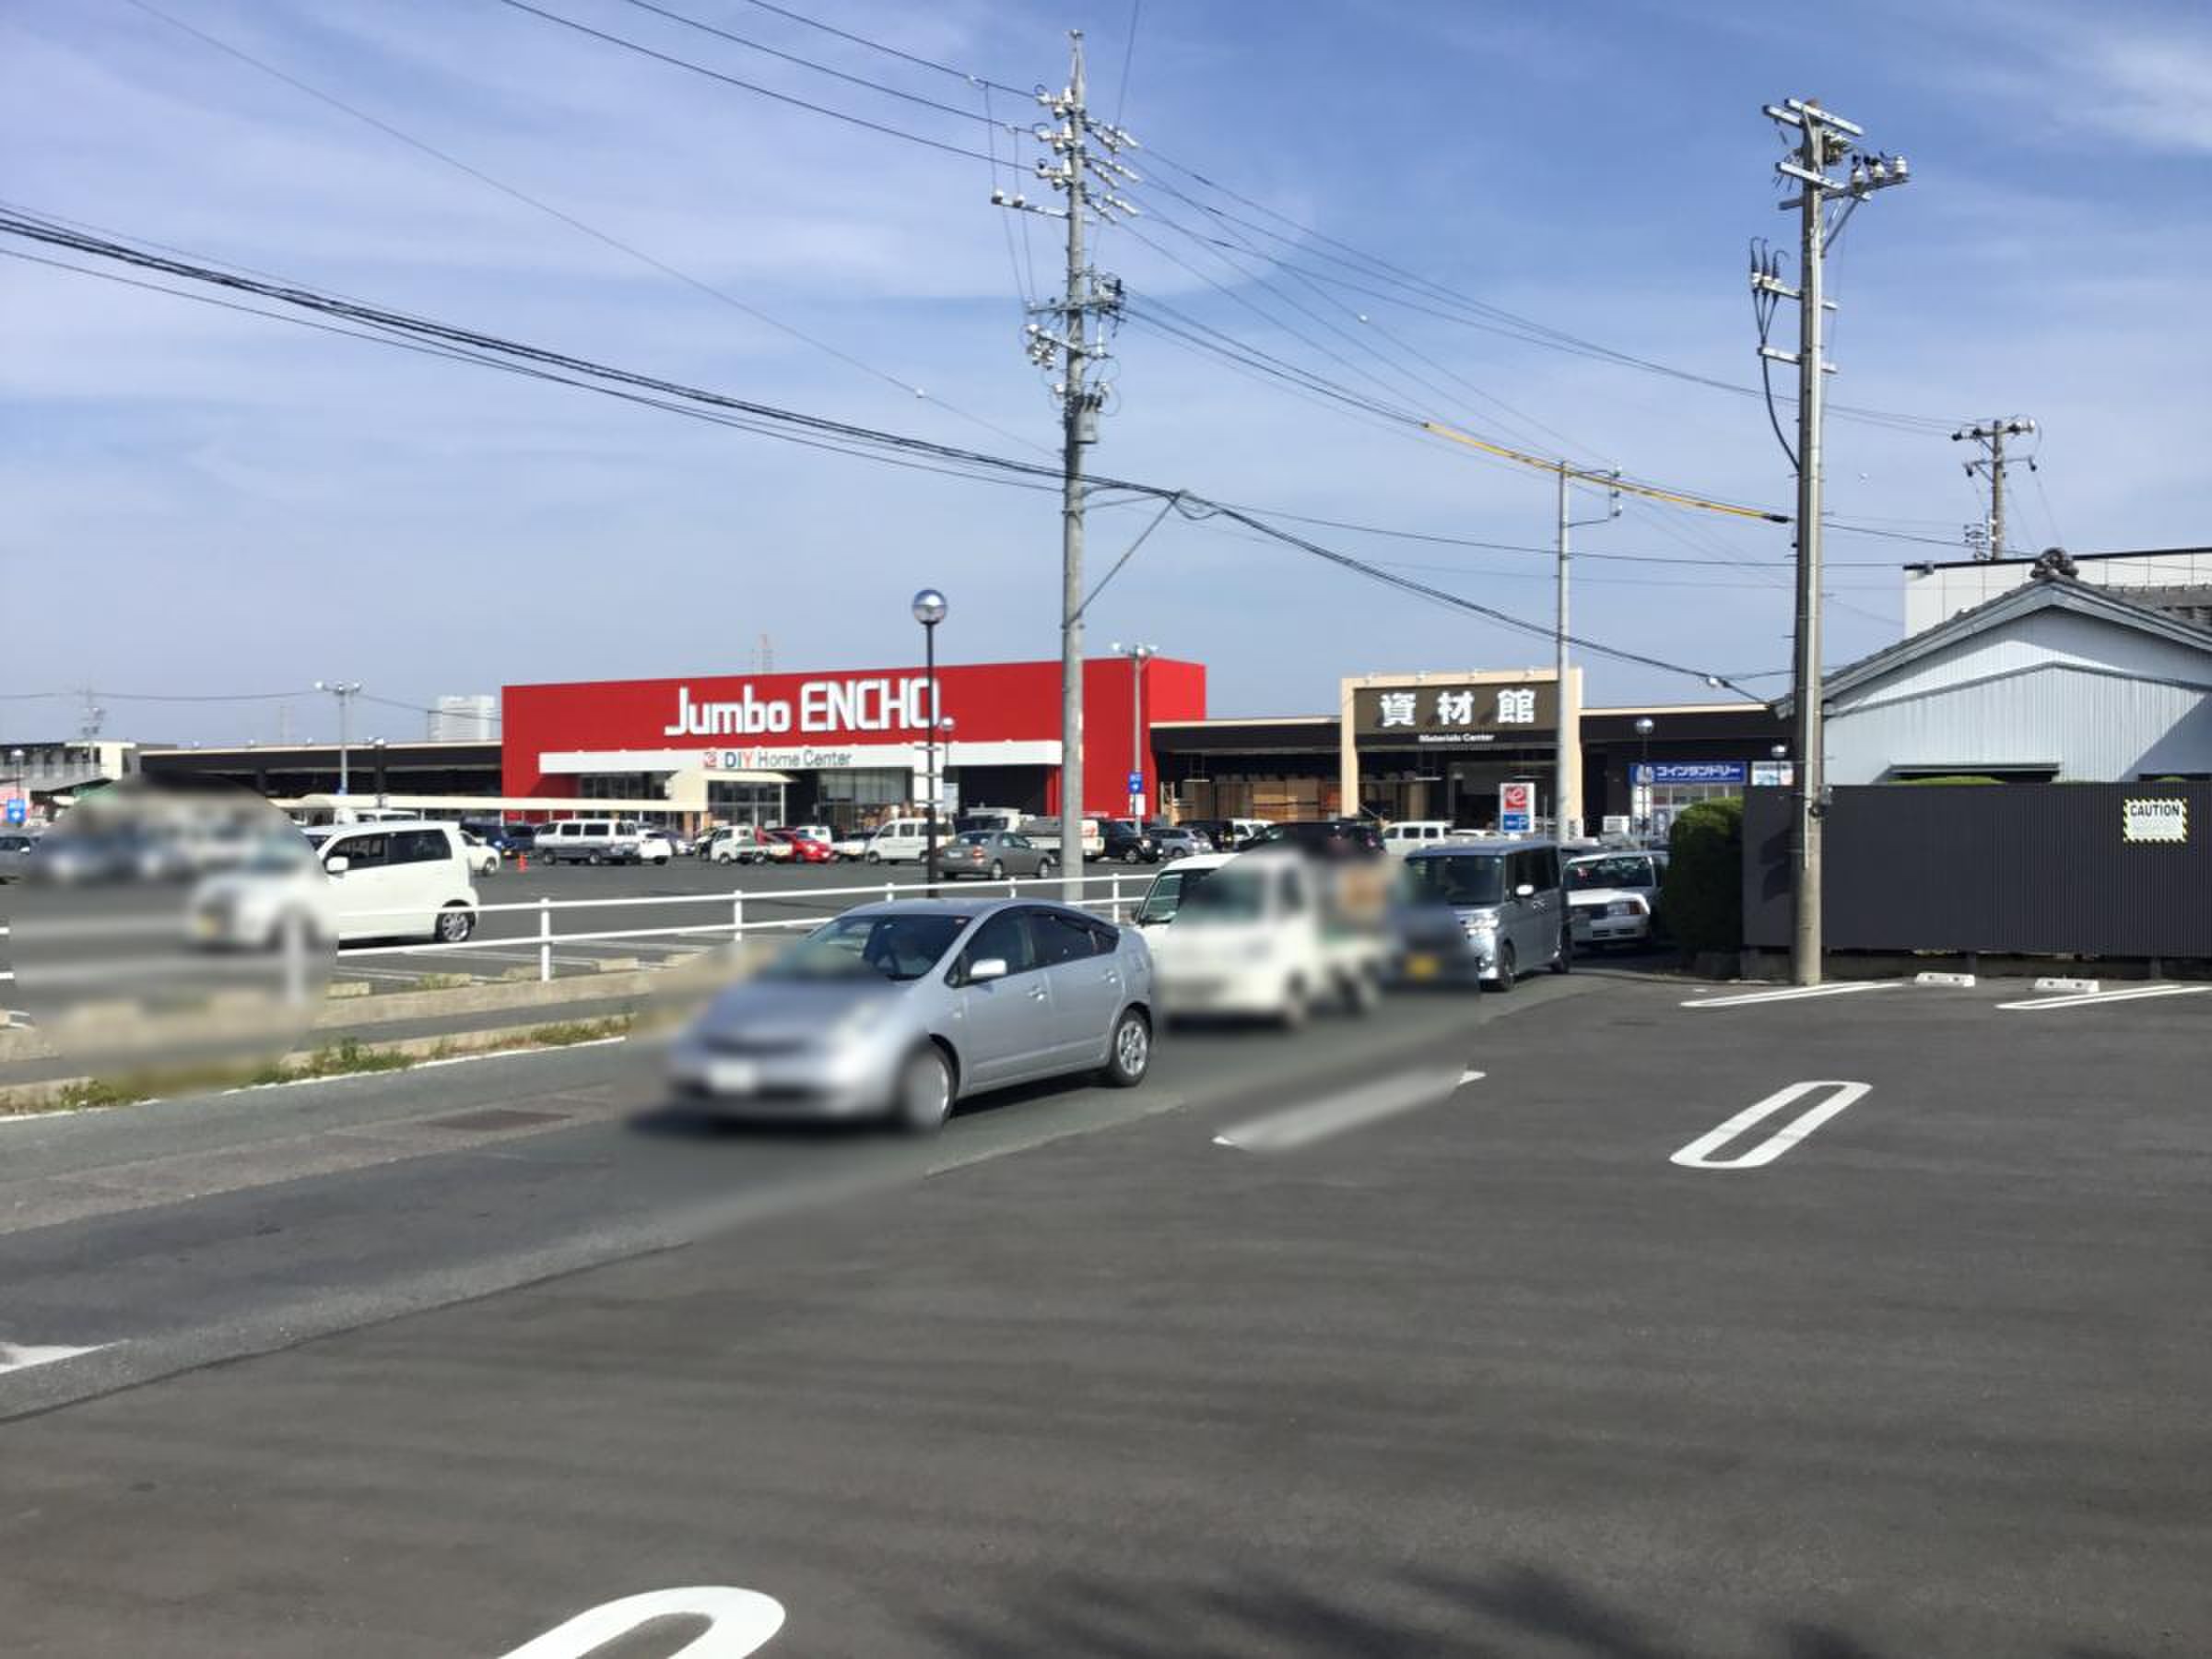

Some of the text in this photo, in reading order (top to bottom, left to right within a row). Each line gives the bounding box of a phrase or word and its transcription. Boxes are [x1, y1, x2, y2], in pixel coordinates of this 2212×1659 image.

[665, 684, 790, 735] Jumbo
[1380, 688, 1535, 727] 資材館
[724, 751, 752, 768] DIY
[759, 751, 800, 767] Home
[804, 749, 851, 766] Center
[2130, 805, 2180, 817] CAUTION
